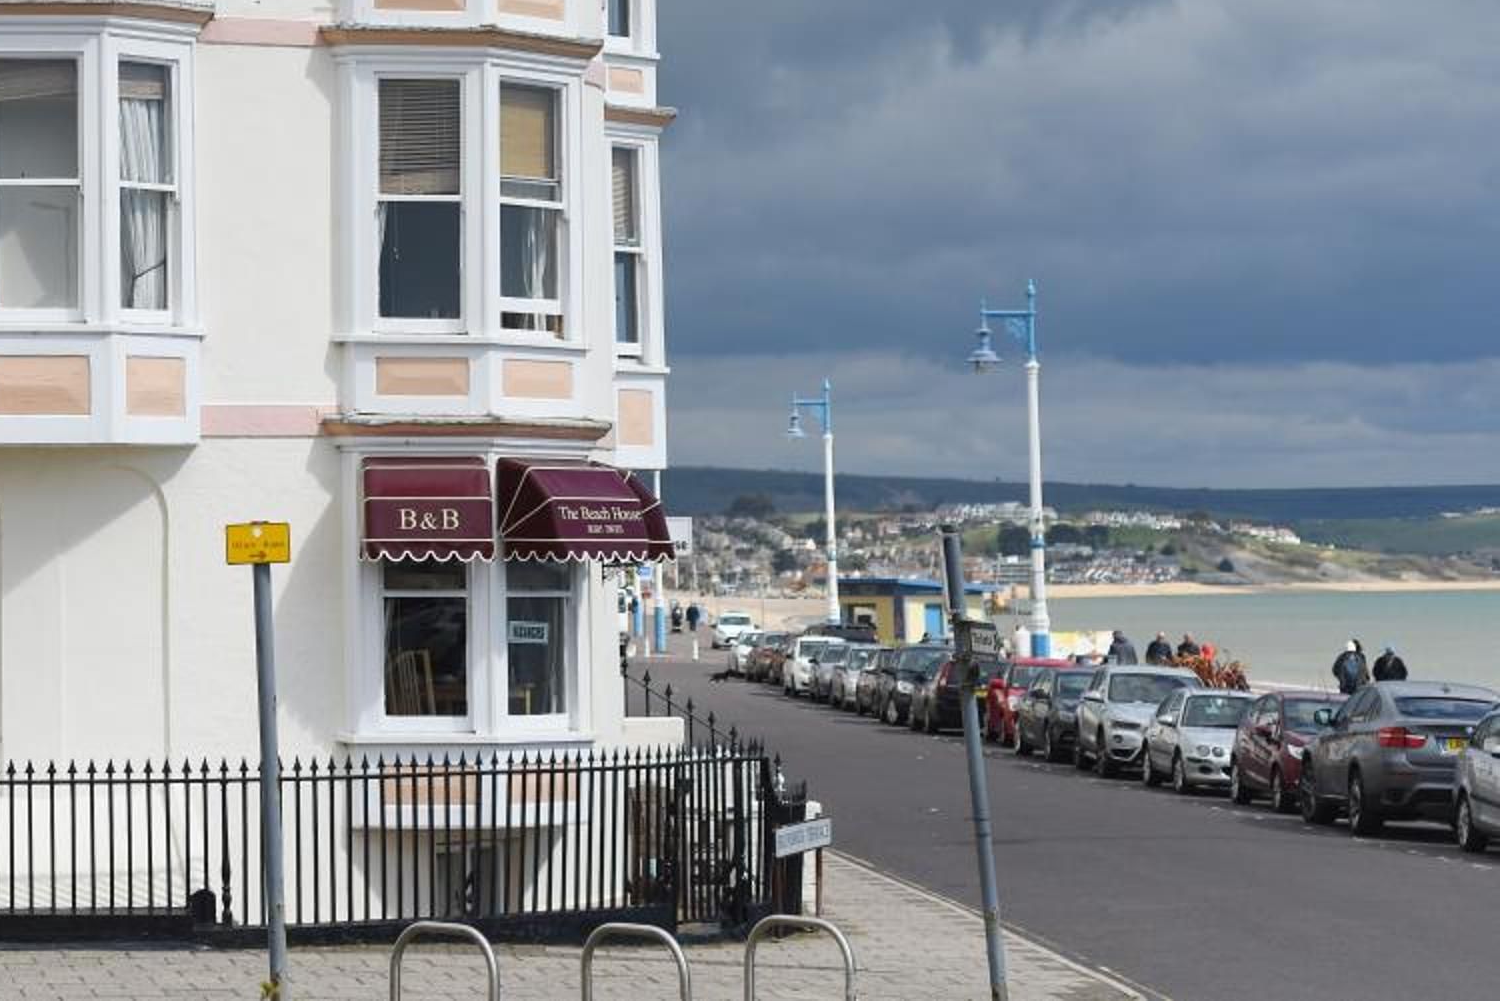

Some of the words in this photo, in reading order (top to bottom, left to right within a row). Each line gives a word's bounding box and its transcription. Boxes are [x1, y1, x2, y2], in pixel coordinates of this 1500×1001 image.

[399, 508, 461, 531] B&B
[558, 506, 579, 520] The
[580, 506, 611, 520] Beach
[612, 506, 642, 521] House
